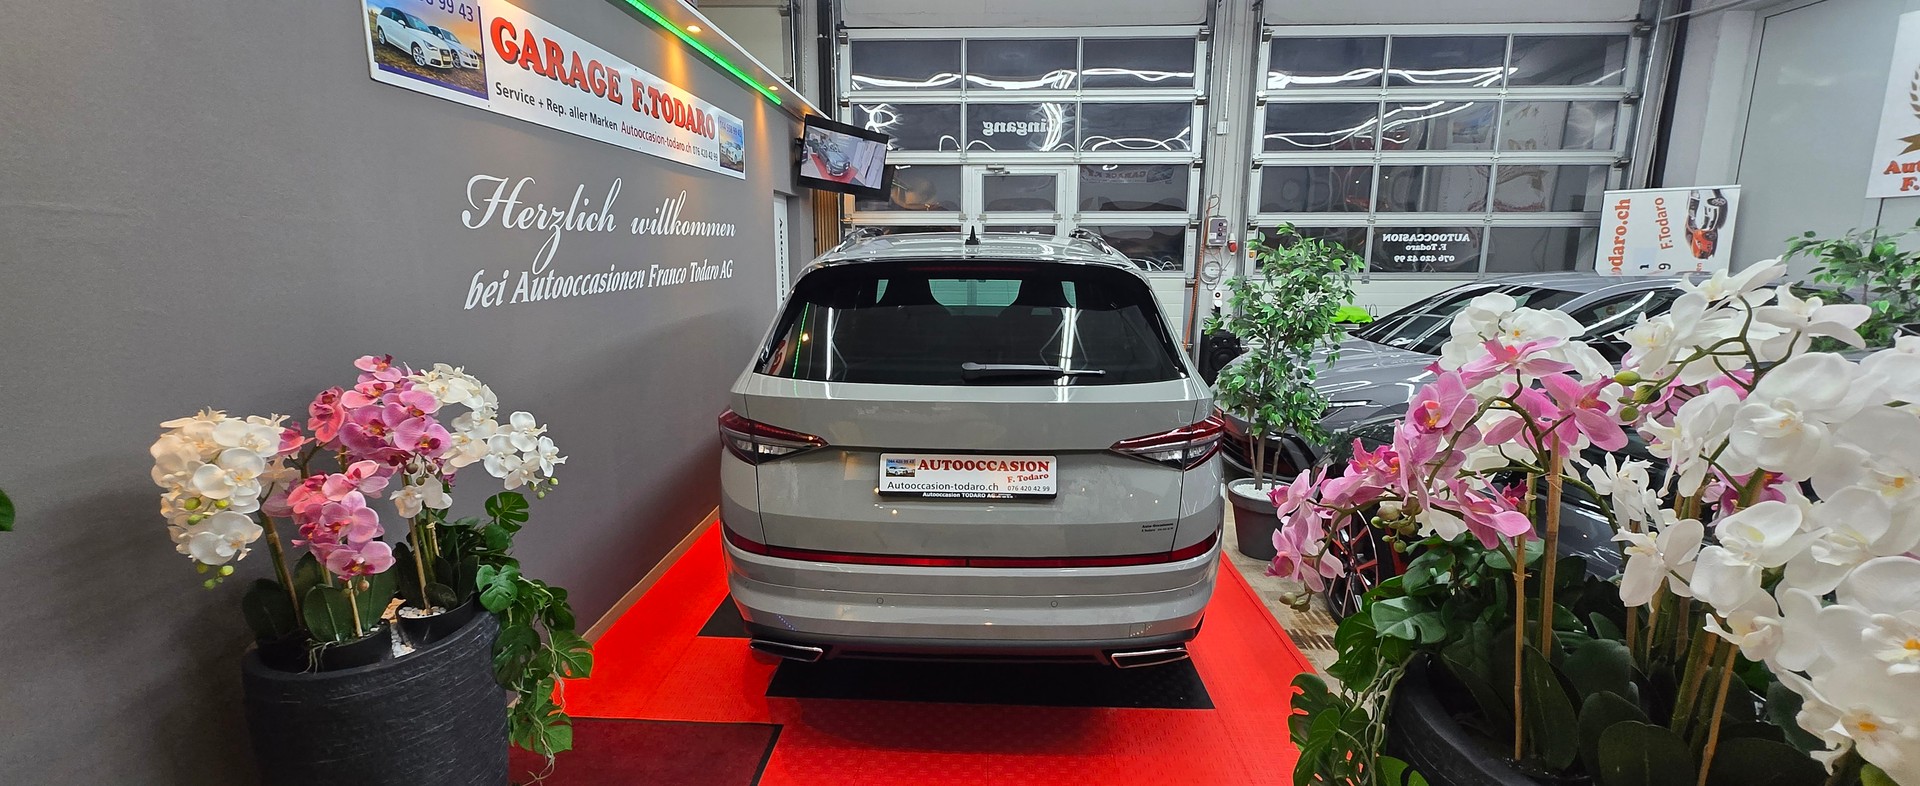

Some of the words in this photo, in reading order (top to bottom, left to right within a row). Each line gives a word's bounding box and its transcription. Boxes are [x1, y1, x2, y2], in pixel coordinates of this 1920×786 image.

[459, 3, 474, 22] 43
[490, 16, 623, 105] GARAGE
[631, 78, 715, 140] F.TODARO
[495, 82, 535, 106] Service
[538, 99, 544, 108] +
[546, 98, 567, 117] Rep.
[569, 106, 588, 121] aller
[590, 112, 618, 131] Marken
[621, 121, 692, 154] Autooccasion-todaro.ch
[692, 145, 700, 156] 076
[708, 150, 713, 160] 42
[713, 152, 718, 162] 99
[1900, 176, 1920, 191] F.
[462, 174, 622, 275] Herzlich
[631, 190, 736, 237] willkommen
[464, 269, 510, 310] bei
[510, 263, 645, 304] Autooccasionen
[648, 264, 687, 288] Franco
[689, 260, 719, 283] Todaro
[719, 260, 734, 279] AG
[917, 459, 1050, 472] AUTOOCCASION
[887, 481, 999, 491] Autooccasion-todaro.ch
[1007, 475, 1015, 483] F.
[1017, 472, 1049, 482] Todaro
